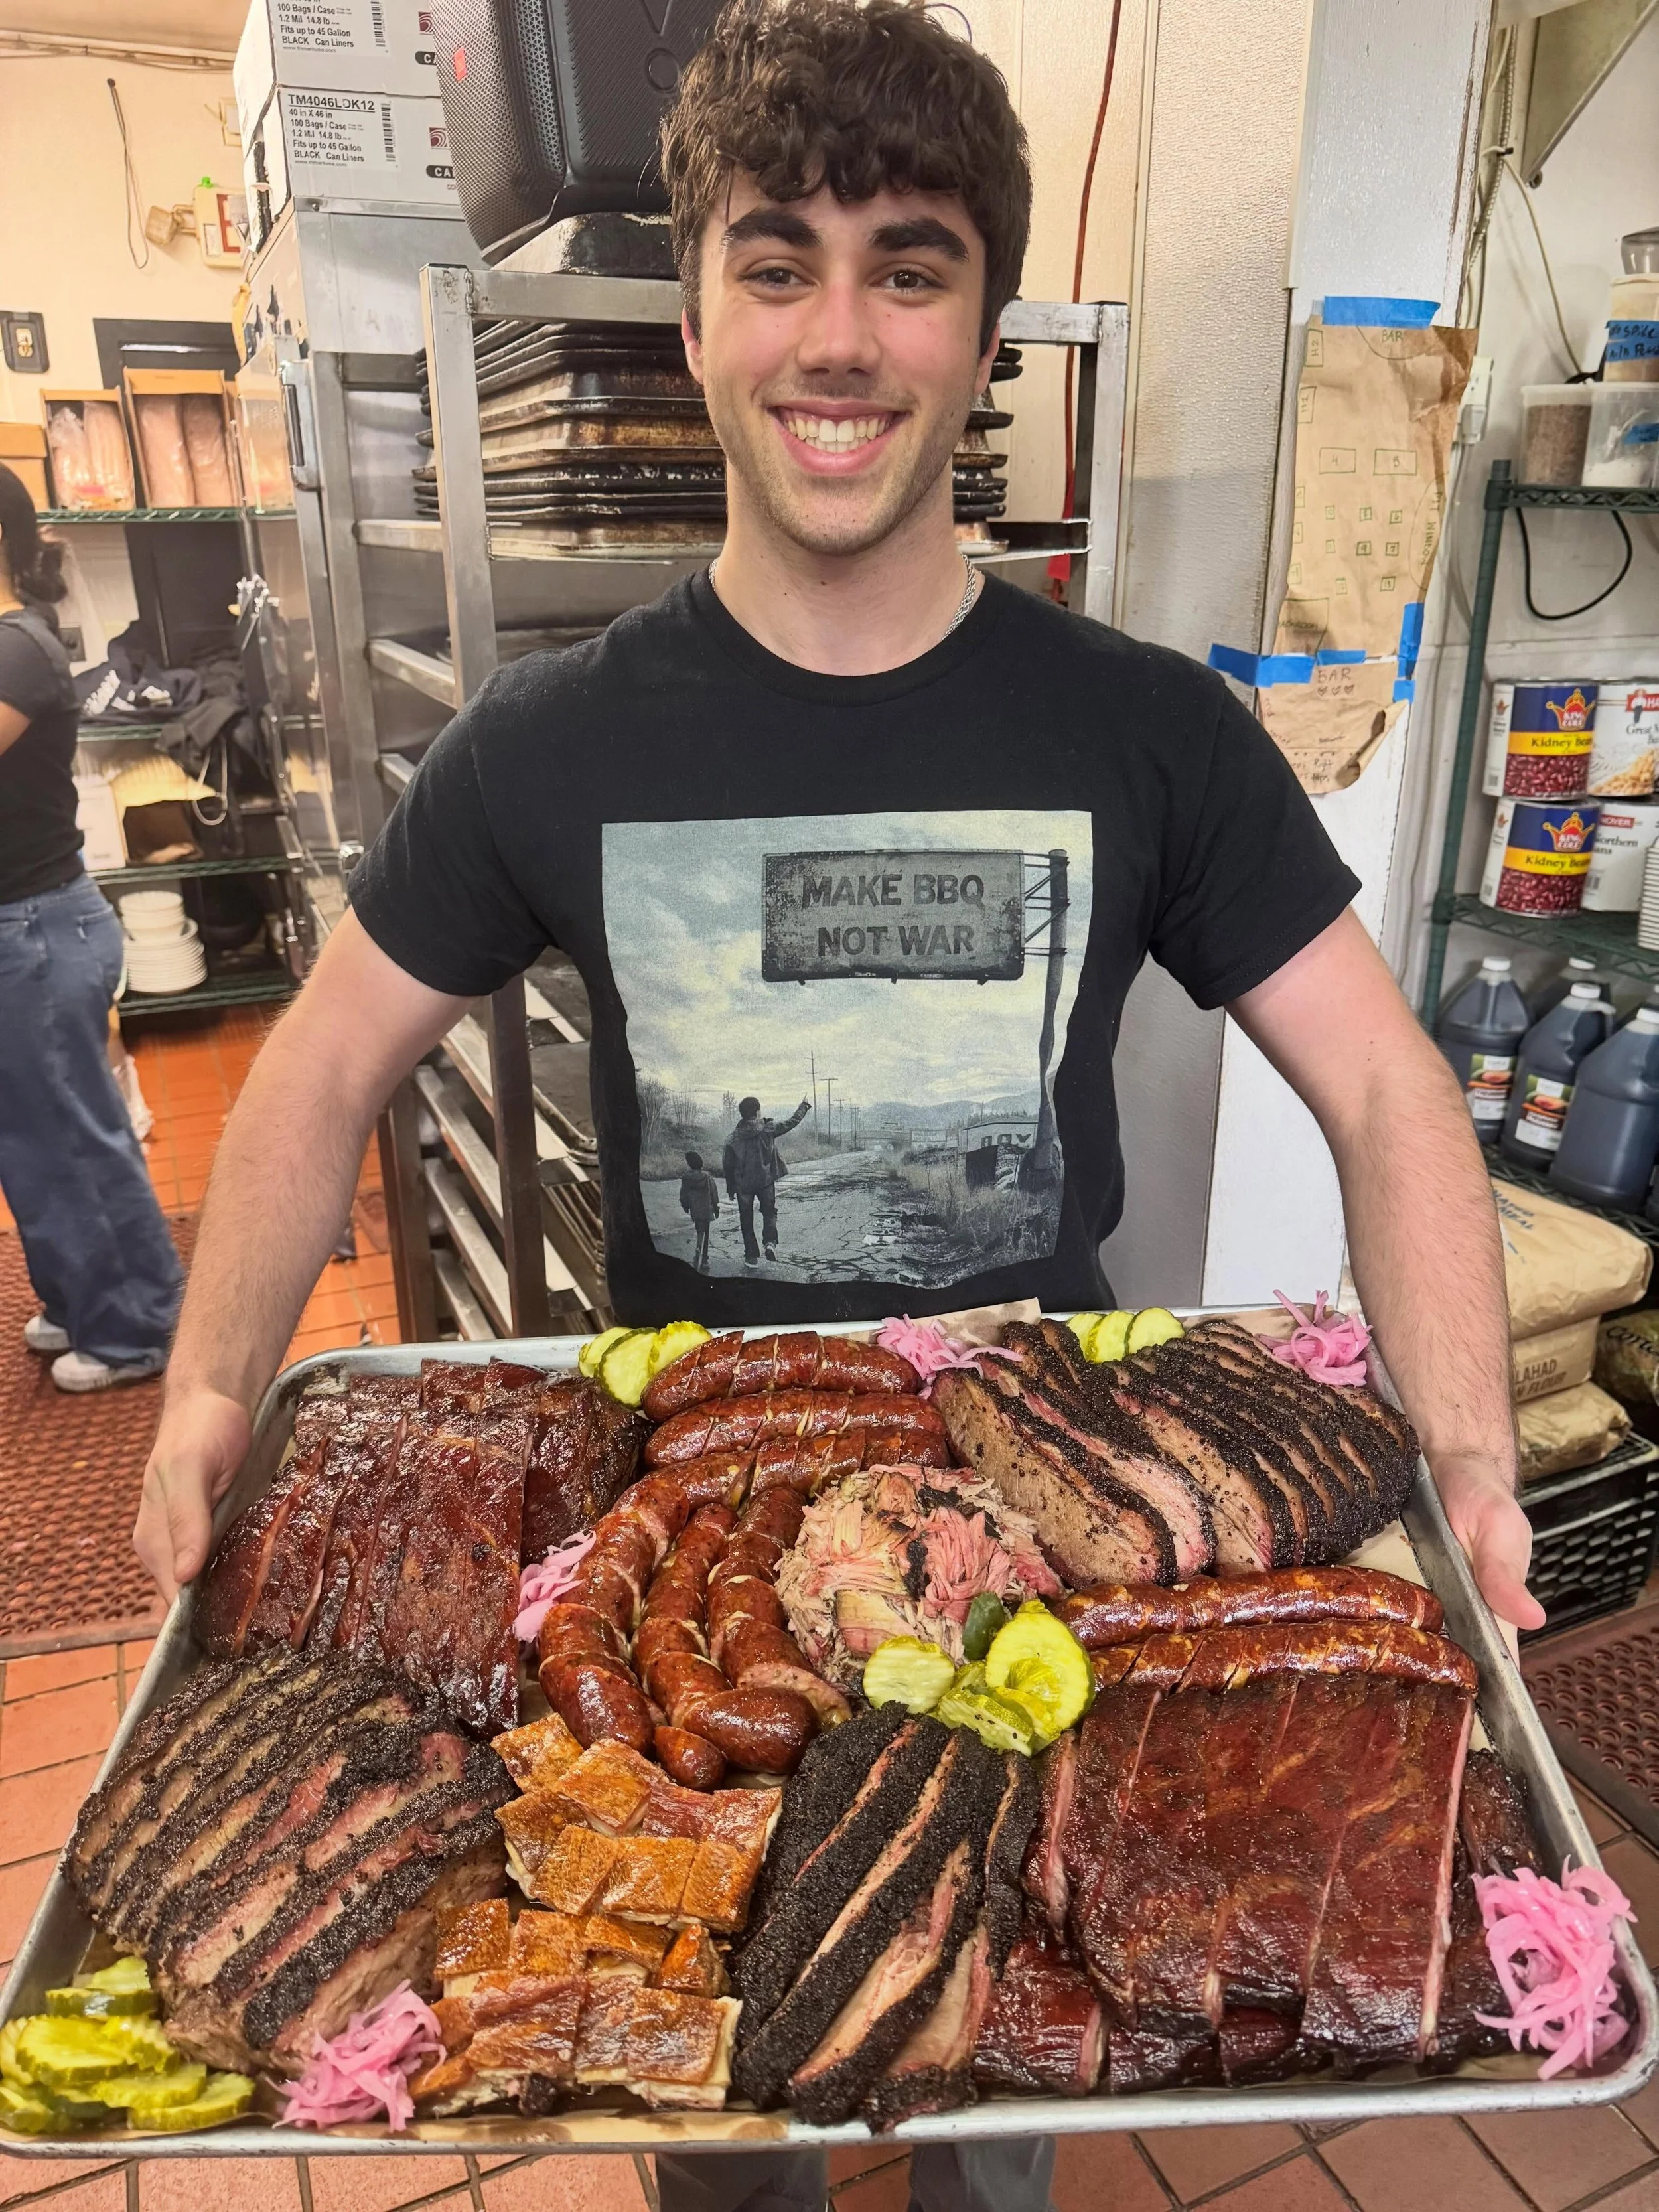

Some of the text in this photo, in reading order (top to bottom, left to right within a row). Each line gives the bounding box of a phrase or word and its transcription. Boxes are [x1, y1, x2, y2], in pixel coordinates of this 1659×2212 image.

[292, 5, 311, 14] Bags
[317, 6, 335, 15] Case
[280, 25, 294, 34] Fits
[327, 29, 351, 37] Gallon
[282, 36, 354, 48] BLACK Can Liners
[290, 119, 303, 127] 100
[305, 120, 323, 130] Bags
[329, 121, 347, 131] Case
[309, 142, 317, 151] up
[338, 143, 362, 152] Gallon
[294, 150, 364, 162] BLACK Can Liners
[1382, 329, 1403, 342] BAR
[1317, 667, 1352, 684] BAR
[1531, 737, 1572, 750] Kidney
[1525, 855, 1566, 869] Kidney
[802, 874, 985, 913] MAKE BBQ
[818, 925, 974, 957] NOT WAR
